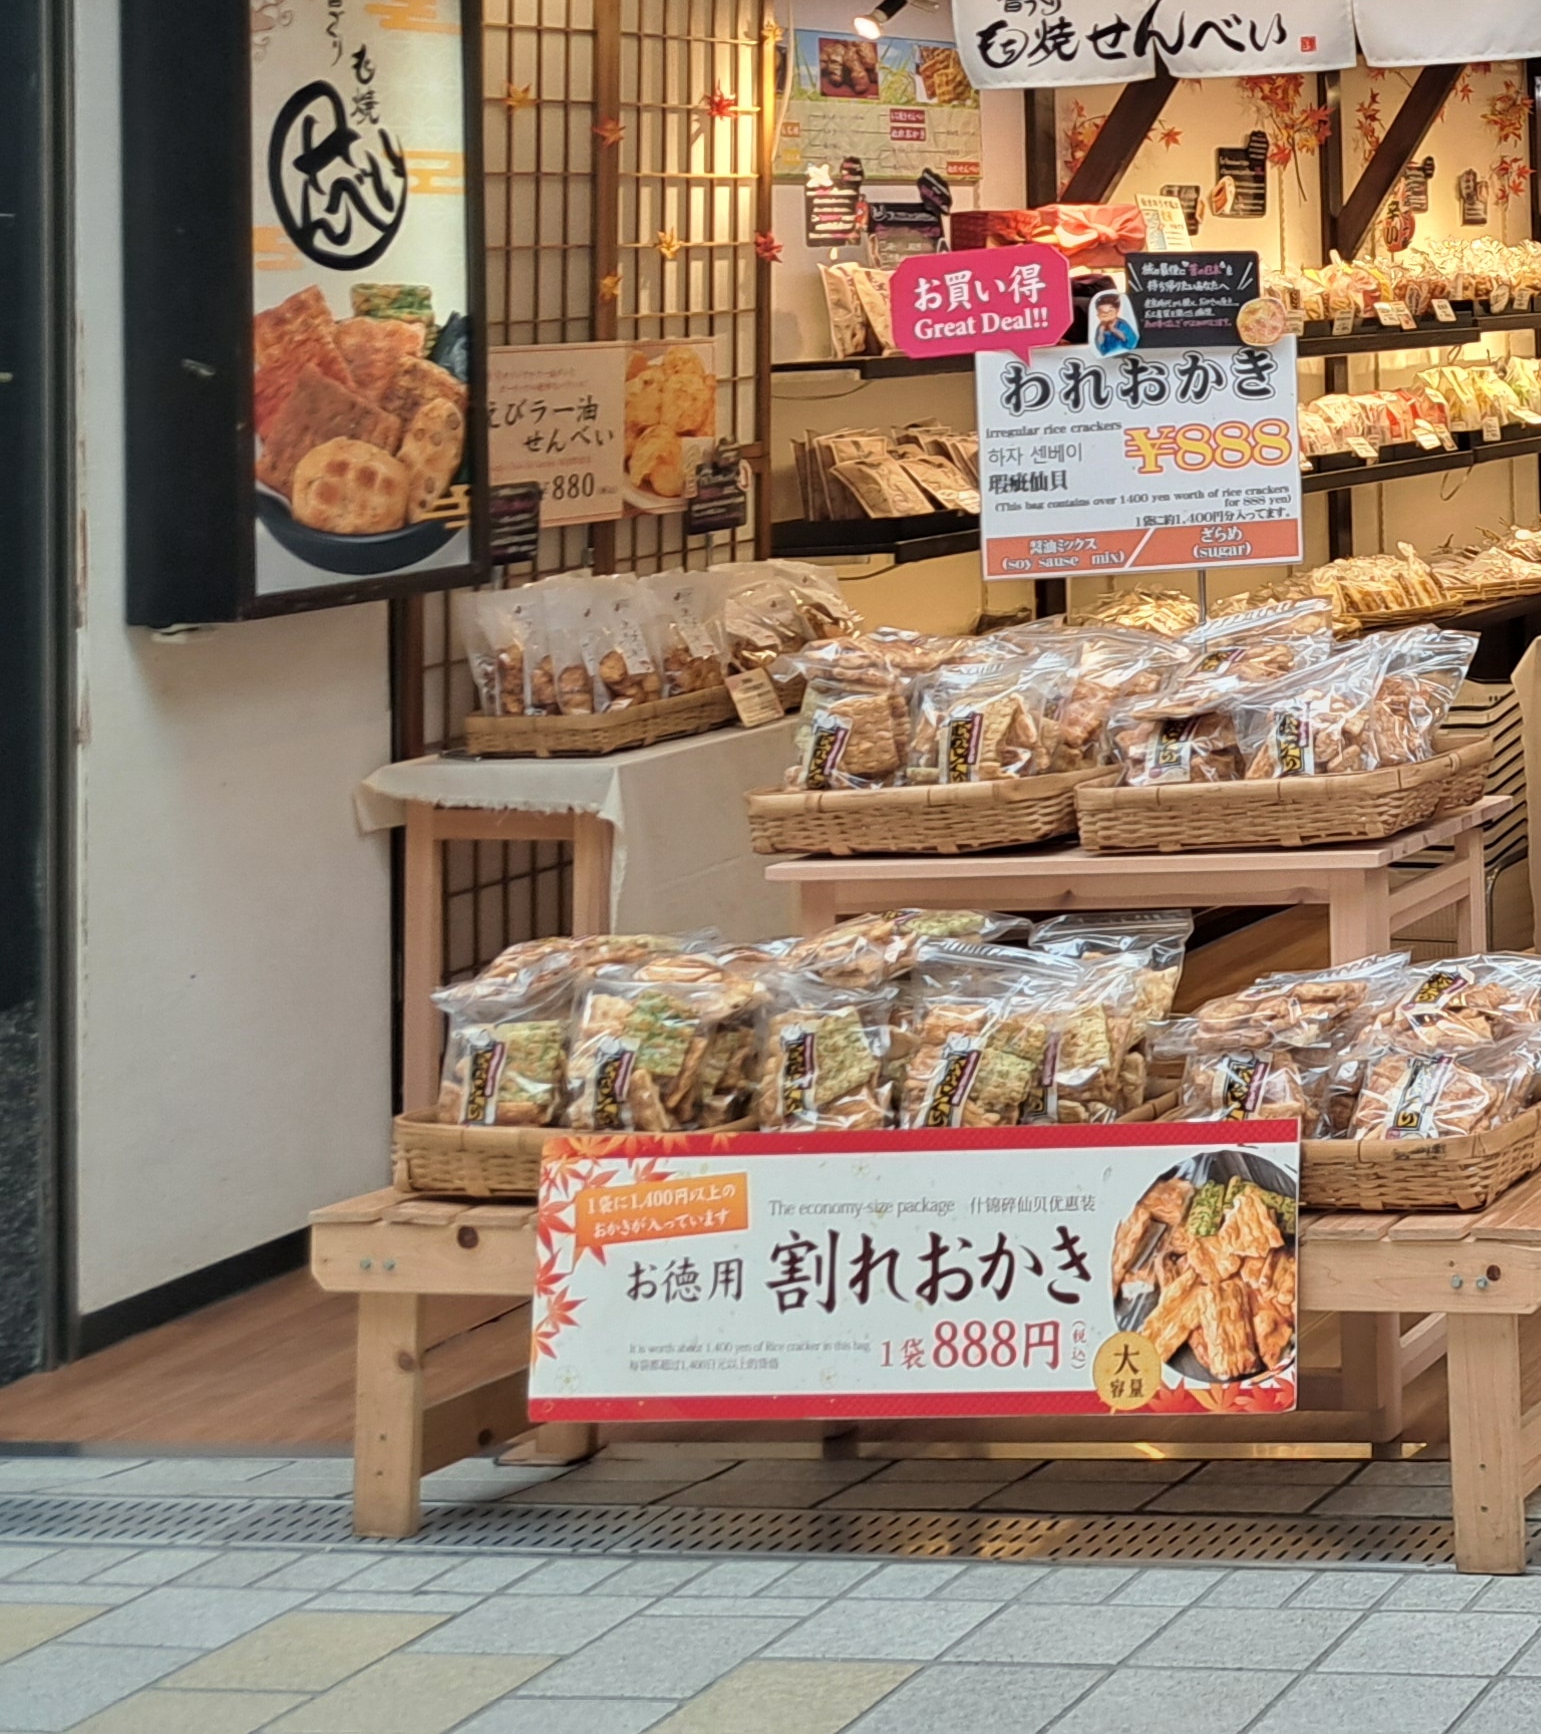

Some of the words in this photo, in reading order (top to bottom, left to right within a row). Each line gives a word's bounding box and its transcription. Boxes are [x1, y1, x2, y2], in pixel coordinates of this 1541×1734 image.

[912, 263, 1047, 313] お買い得
[914, 309, 975, 340] Great
[980, 305, 1050, 333] Deal!!
[1003, 348, 1276, 414] われおかき
[1043, 423, 1067, 435] rice
[1070, 420, 1123, 434] crackers
[524, 428, 614, 454] せんべい
[1124, 418, 1293, 474] ¥888
[988, 447, 1023, 466] 하자
[1031, 443, 1083, 465] 센베이
[1047, 498, 1090, 510] contains
[1092, 496, 1117, 506] over
[1119, 493, 1149, 504] 1400
[1151, 493, 1170, 504] yen
[1173, 489, 1205, 500] worth
[1207, 487, 1219, 498] of
[1221, 486, 1242, 497] rice
[1244, 484, 1290, 497] crackers
[1224, 497, 1240, 508] for
[1242, 496, 1266, 506] 888
[1268, 493, 1292, 507] yen)
[1029, 537, 1098, 555] 醤油ミックス
[1200, 526, 1242, 544] ざらめ
[1002, 556, 1033, 571] (soy
[1091, 549, 1126, 566] mix)
[1192, 541, 1252, 560] (sugar)
[769, 1199, 795, 1216] The
[799, 1198, 894, 1217] economy-size
[897, 1197, 956, 1217] package
[594, 1208, 731, 1239] おかきが入っています
[626, 1256, 744, 1303] お徳用
[766, 1225, 1093, 1314] 割れおかき
[1114, 1344, 1141, 1375] 大
[1109, 1378, 1146, 1399] 容量
